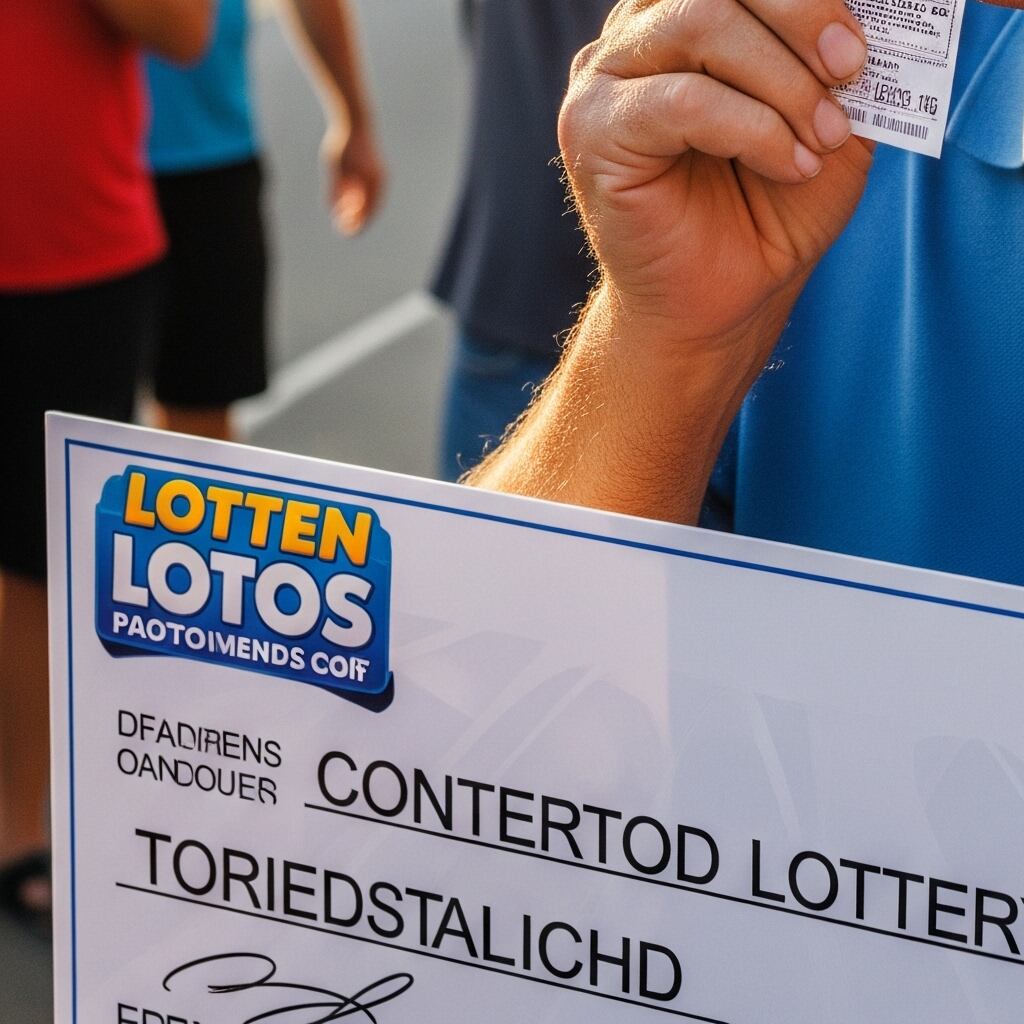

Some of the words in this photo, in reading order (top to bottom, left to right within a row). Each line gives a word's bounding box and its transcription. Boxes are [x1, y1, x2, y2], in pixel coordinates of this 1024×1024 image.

[124, 472, 372, 566] LOTTEN
[112, 533, 373, 648] LOTOS
[318, 751, 719, 884] CONTERTOD
[135, 828, 683, 1002] TORIEDSTALICHD
